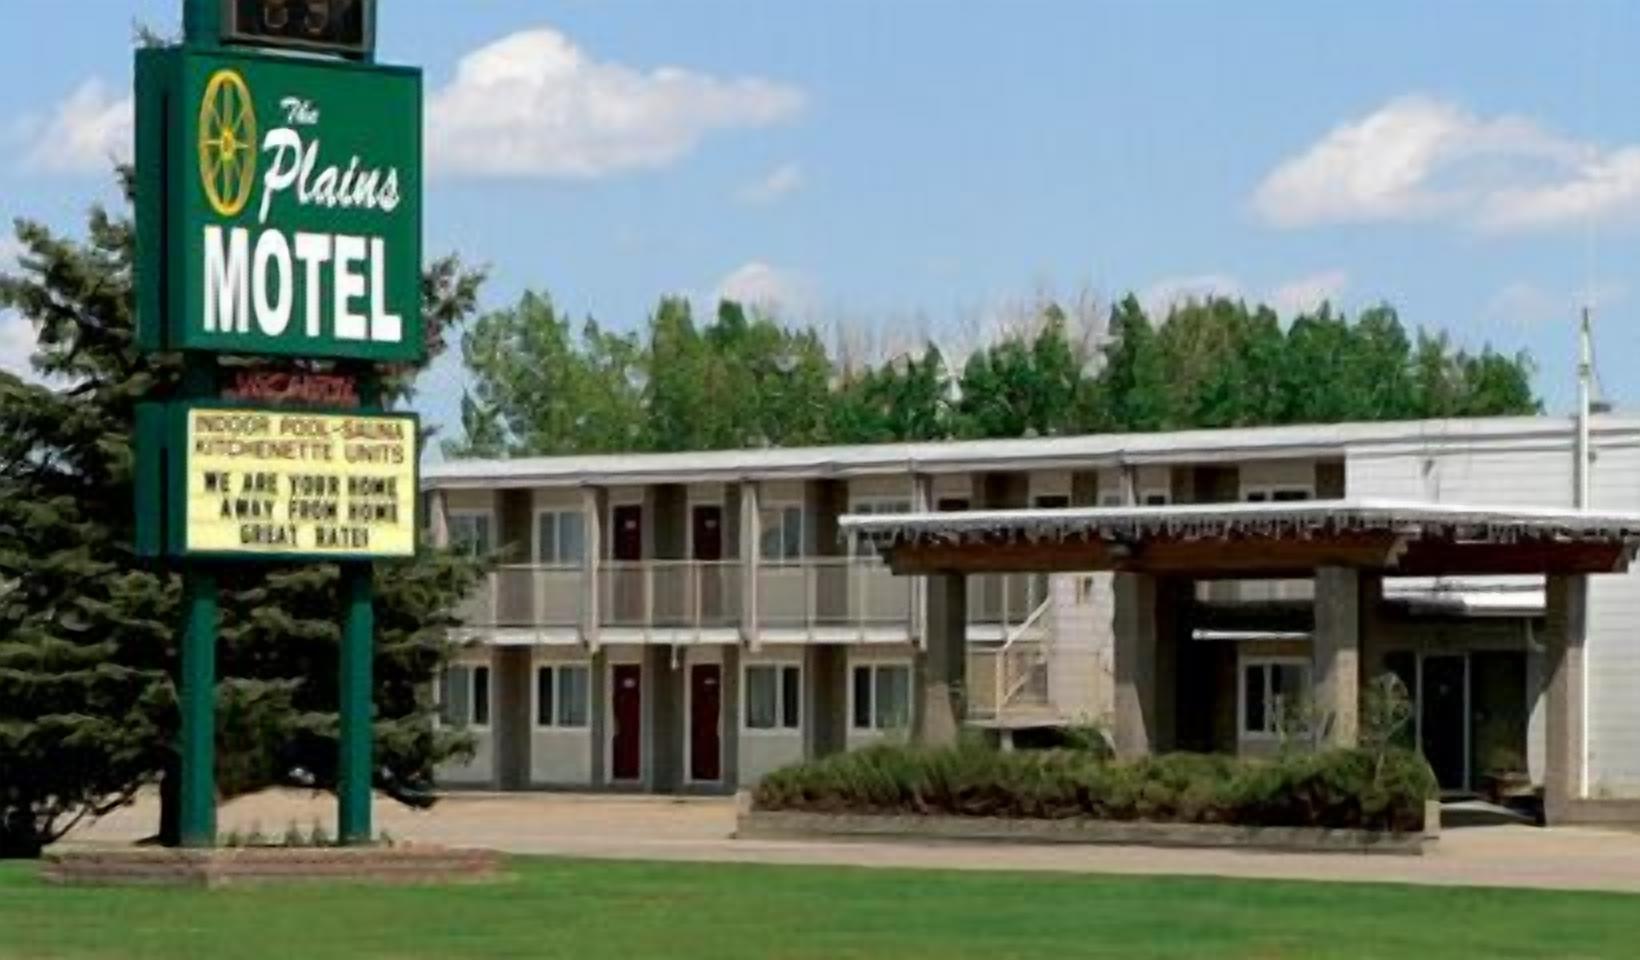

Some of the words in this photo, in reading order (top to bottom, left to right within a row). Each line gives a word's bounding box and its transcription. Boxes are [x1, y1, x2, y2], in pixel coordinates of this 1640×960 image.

[280, 97, 320, 124] The
[259, 128, 401, 224] Plains
[203, 225, 402, 342] MOTEL
[344, 444, 404, 464] UNITS
[204, 472, 231, 493] WE
[243, 473, 278, 495] ARE
[289, 475, 340, 496] YOUR
[348, 476, 397, 498] HOME
[220, 498, 275, 518] AWAY
[288, 500, 337, 520] FROM
[348, 502, 398, 524] HOME
[240, 524, 298, 546] GREAT
